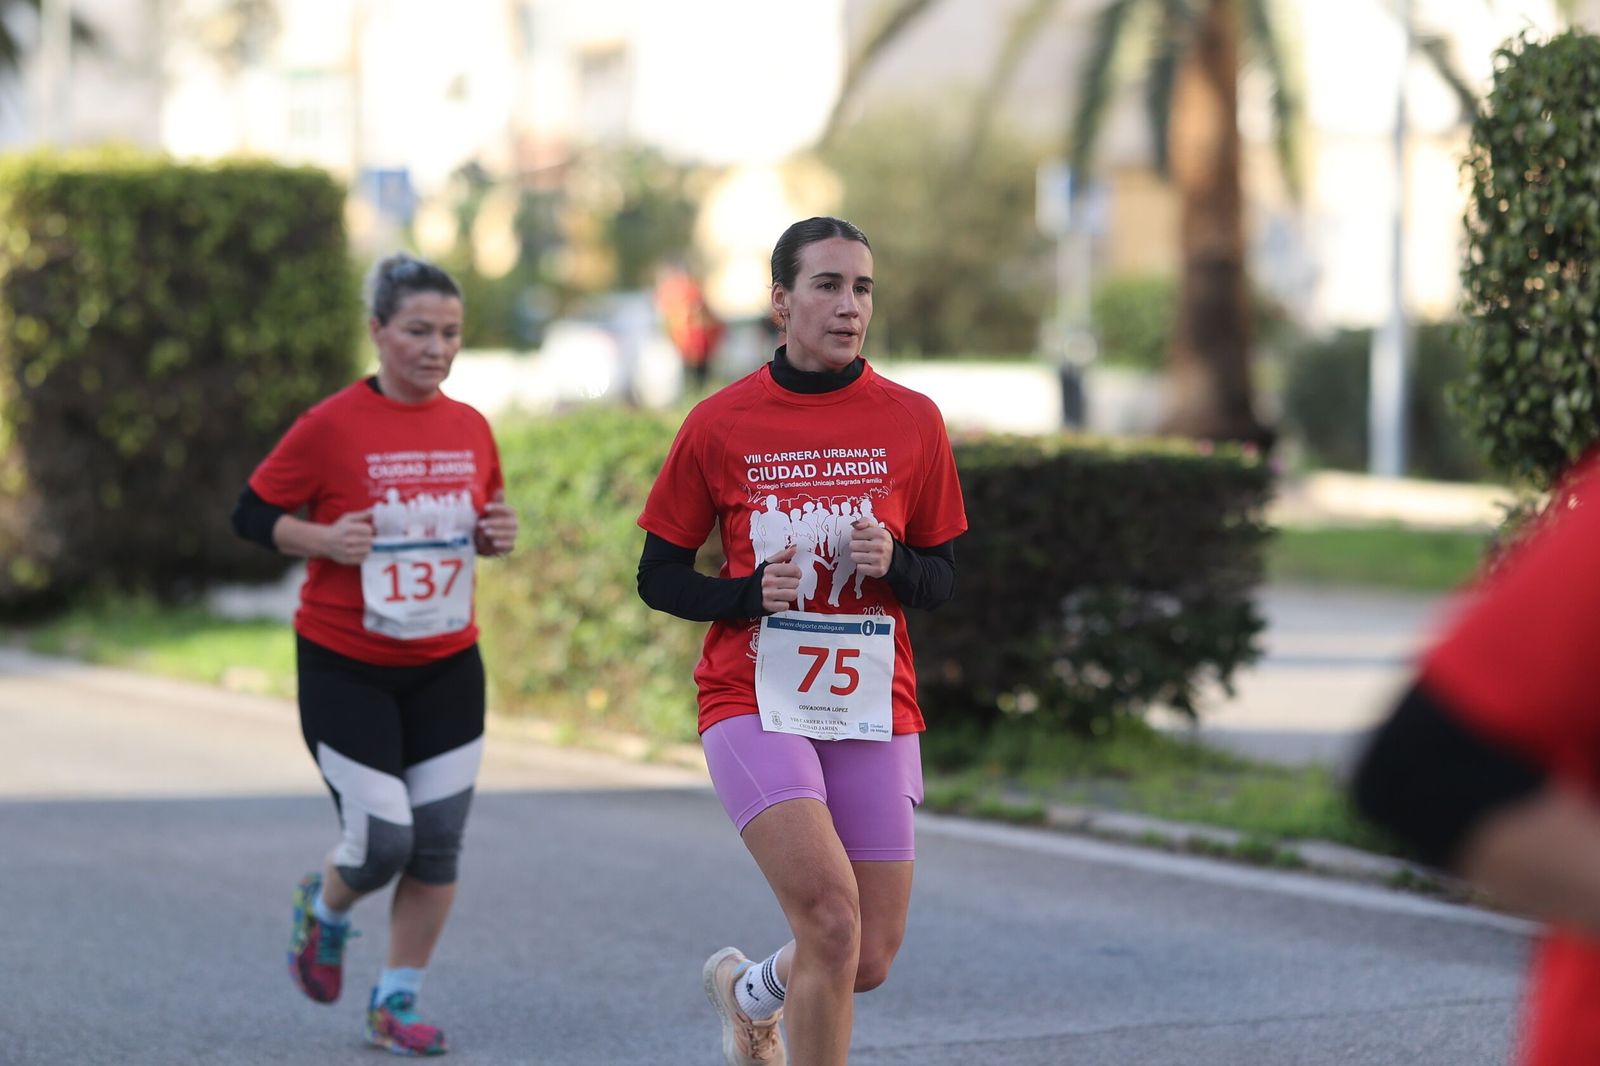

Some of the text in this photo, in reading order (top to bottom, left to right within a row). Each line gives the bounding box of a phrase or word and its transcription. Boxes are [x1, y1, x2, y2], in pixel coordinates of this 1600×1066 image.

[743, 448, 887, 464] VIII CARRERA URBANA DE
[747, 458, 888, 482] CIUDAD JARDÍN
[756, 483, 779, 491] Colegio
[780, 480, 812, 489] Fundación
[812, 479, 835, 487] Unicaja
[836, 478, 860, 487] Sagrada
[383, 559, 464, 603] 137
[779, 621, 844, 631] www.deporte.malaga.eu
[797, 645, 861, 696] 75
[832, 705, 849, 713] LÓPEZ
